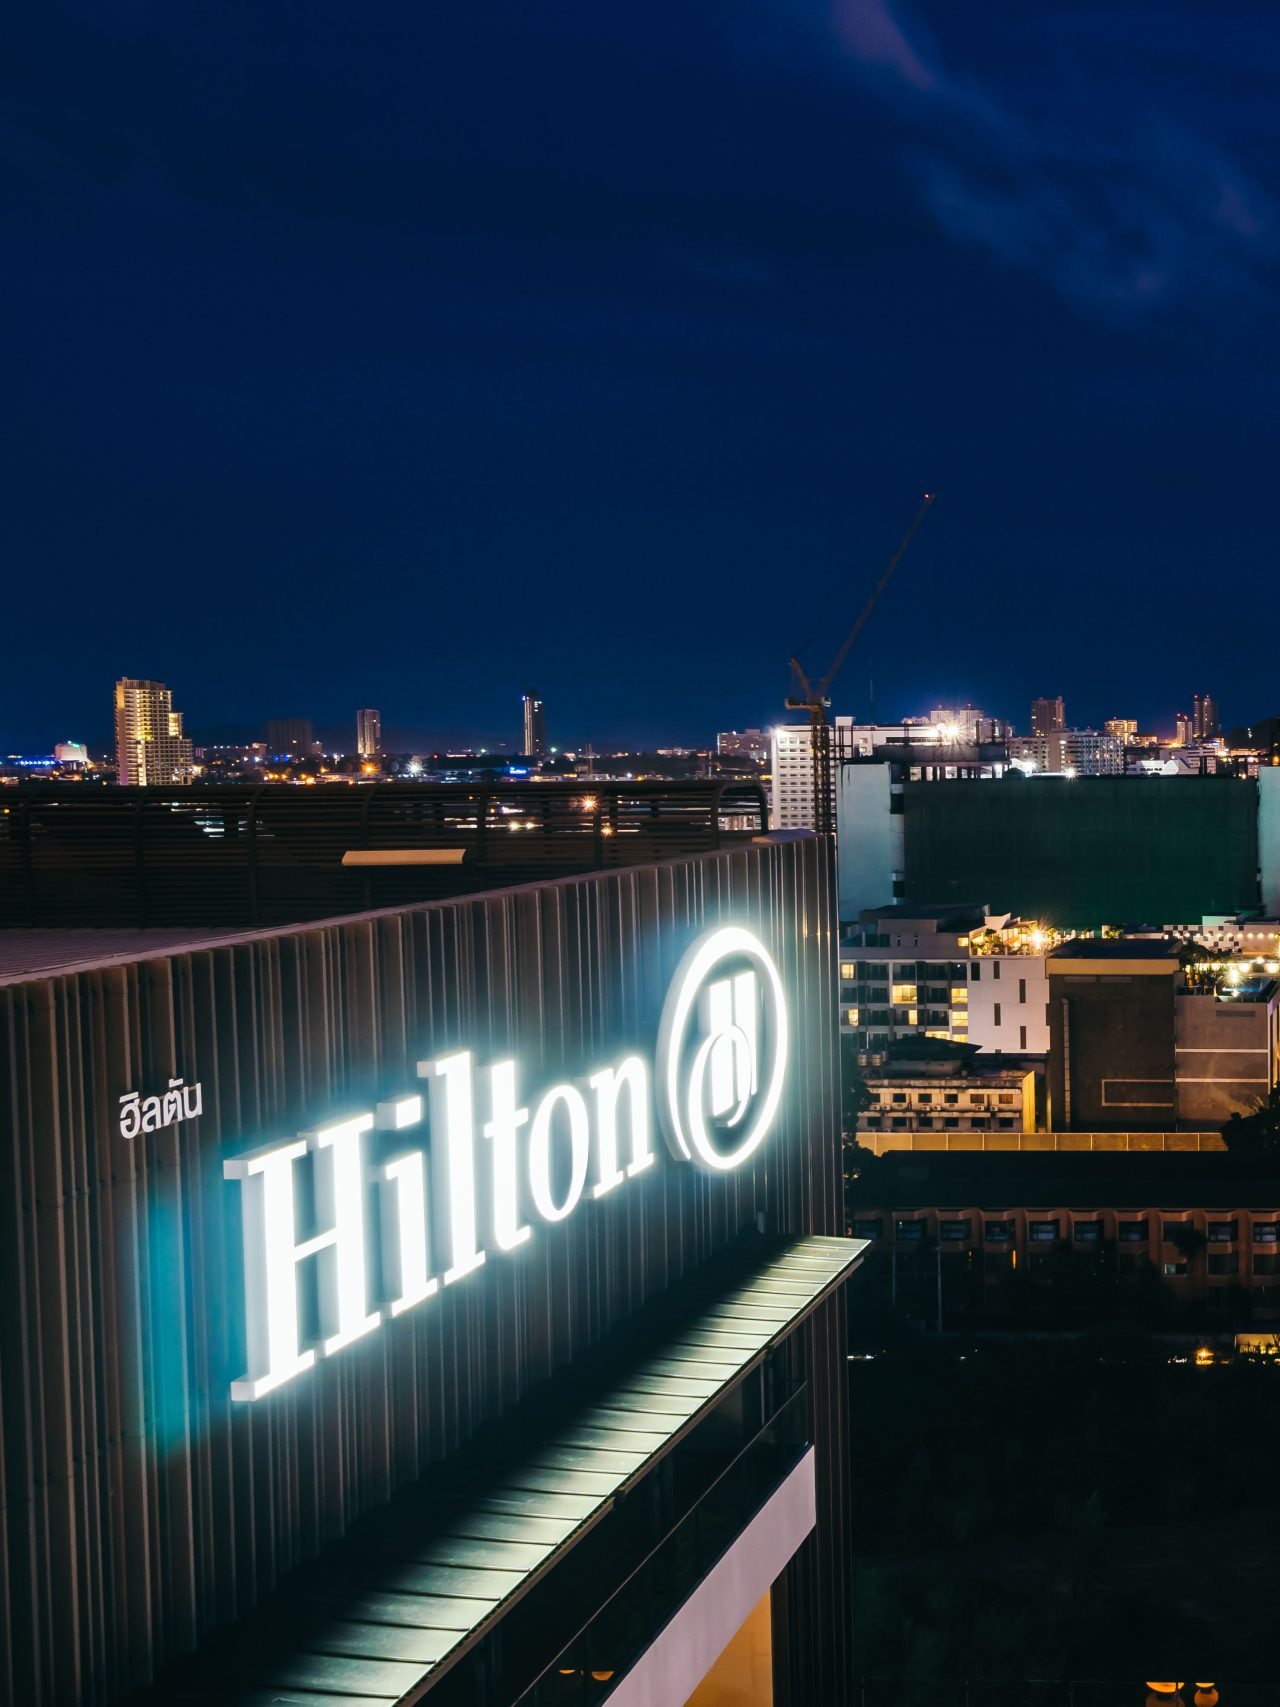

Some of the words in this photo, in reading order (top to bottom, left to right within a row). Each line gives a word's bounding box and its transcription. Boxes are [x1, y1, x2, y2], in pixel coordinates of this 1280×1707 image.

[119, 1078, 203, 1139] ฮิลตัน
[223, 1051, 654, 1401] Hilton
